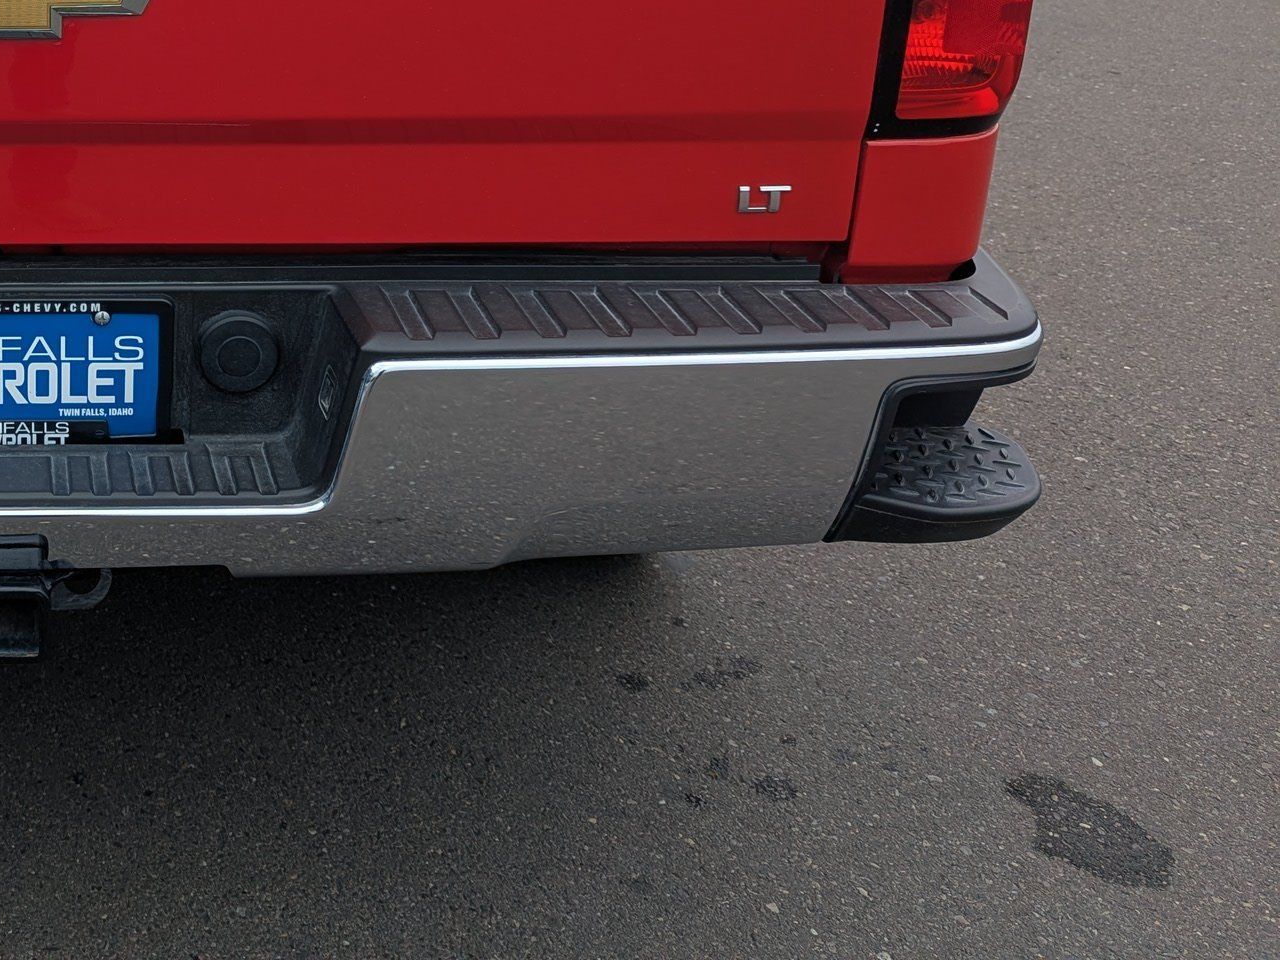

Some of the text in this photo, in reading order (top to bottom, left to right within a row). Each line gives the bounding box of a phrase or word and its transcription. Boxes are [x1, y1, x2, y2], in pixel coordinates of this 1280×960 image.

[737, 184, 793, 213] LT
[58, 407, 134, 418] TWIN FALLS, IDAHO
